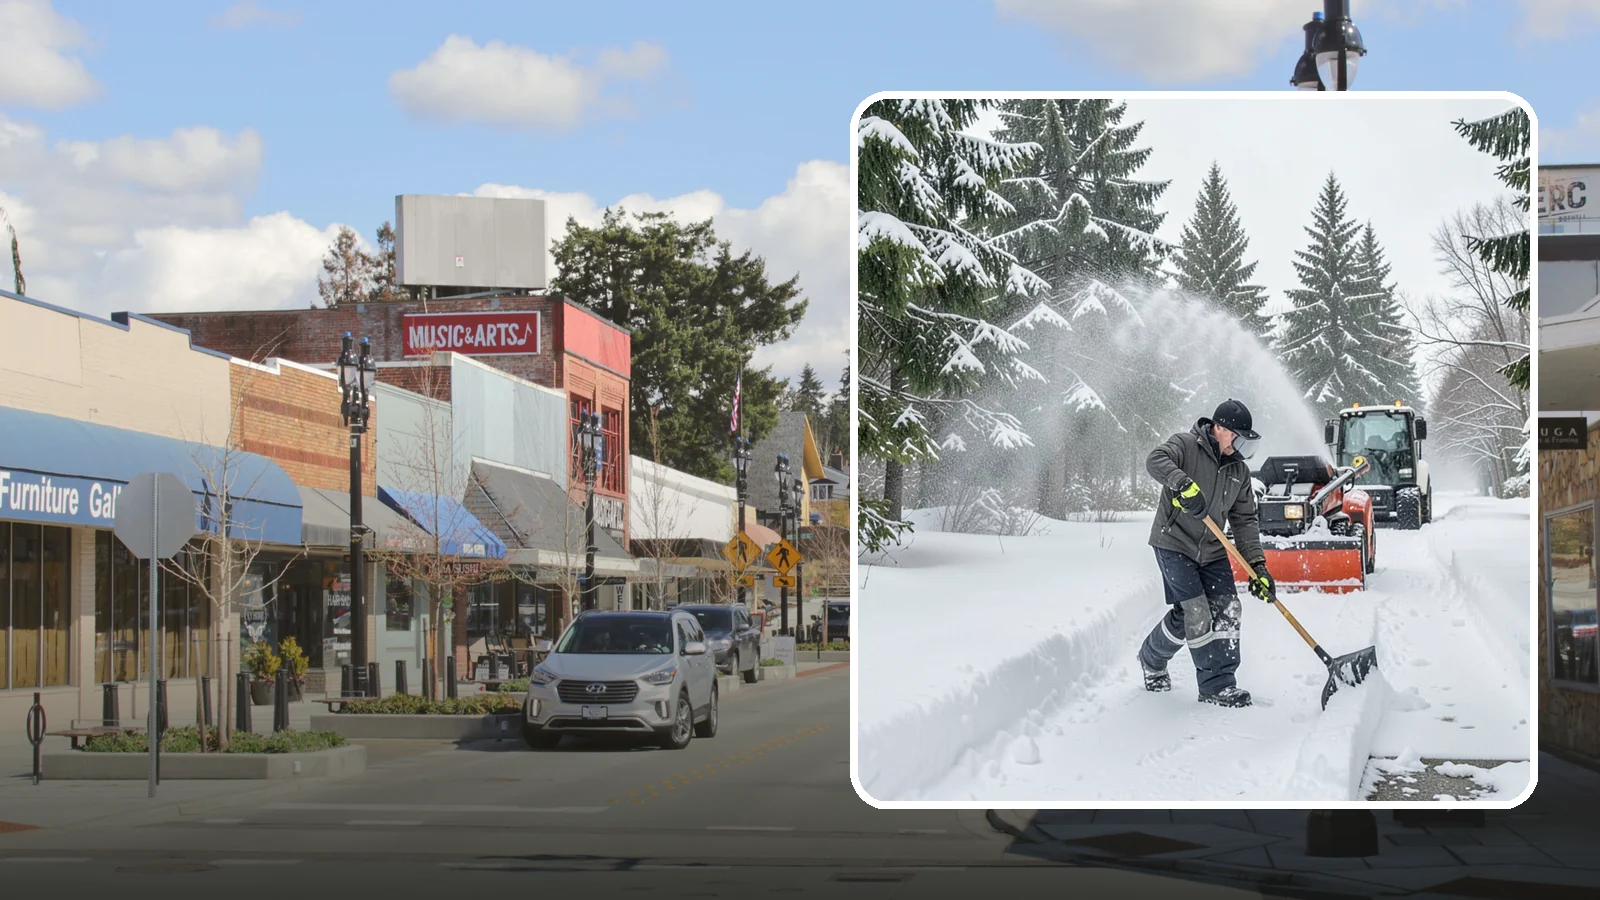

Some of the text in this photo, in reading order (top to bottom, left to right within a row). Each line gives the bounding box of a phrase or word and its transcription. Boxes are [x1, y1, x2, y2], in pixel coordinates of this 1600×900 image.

[0, 472, 121, 519] Furniture Gal
[454, 563, 480, 574] SUSHI
